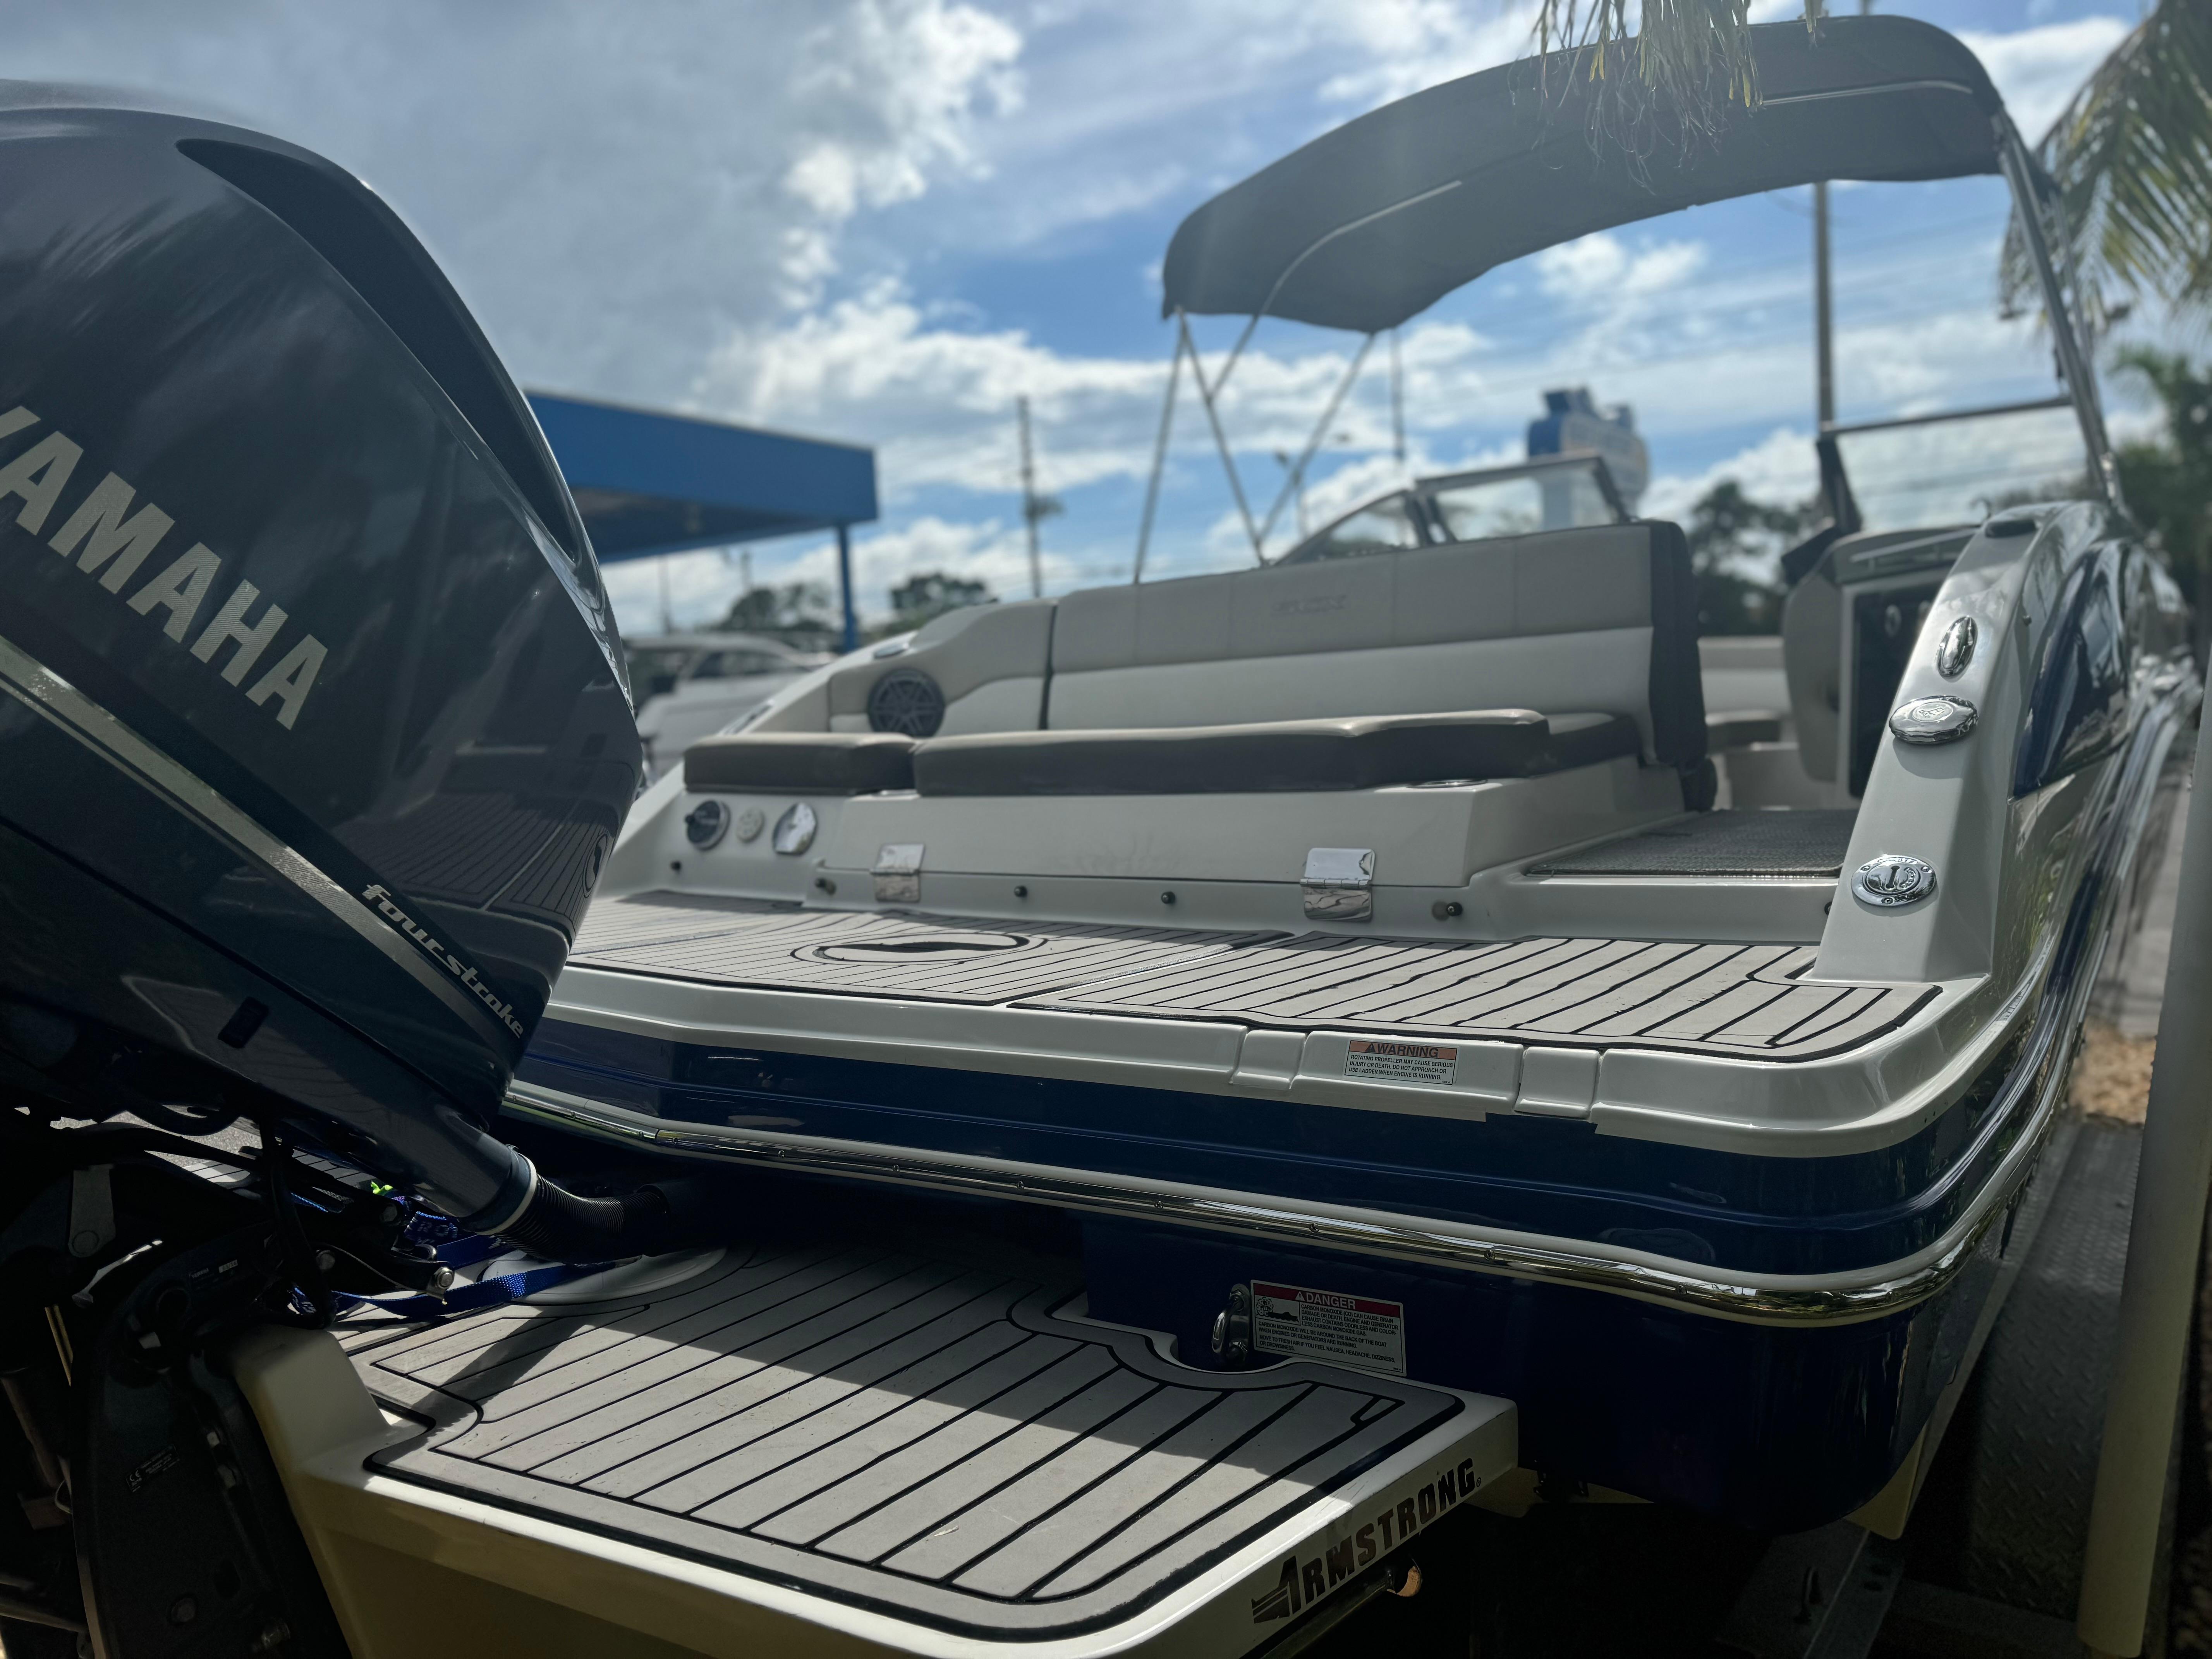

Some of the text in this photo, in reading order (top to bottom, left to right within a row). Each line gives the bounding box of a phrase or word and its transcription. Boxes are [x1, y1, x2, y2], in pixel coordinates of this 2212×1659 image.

[1377, 1043, 1438, 1058] WARNING
[1306, 1292, 1355, 1310] DANGER
[1344, 1322, 1368, 1331] ODORLESS
[1371, 1321, 1398, 1330] GENERATOR
[1298, 1334, 1326, 1343] GENERATORS
[1252, 1458, 1475, 1624] ARMSTRONG
